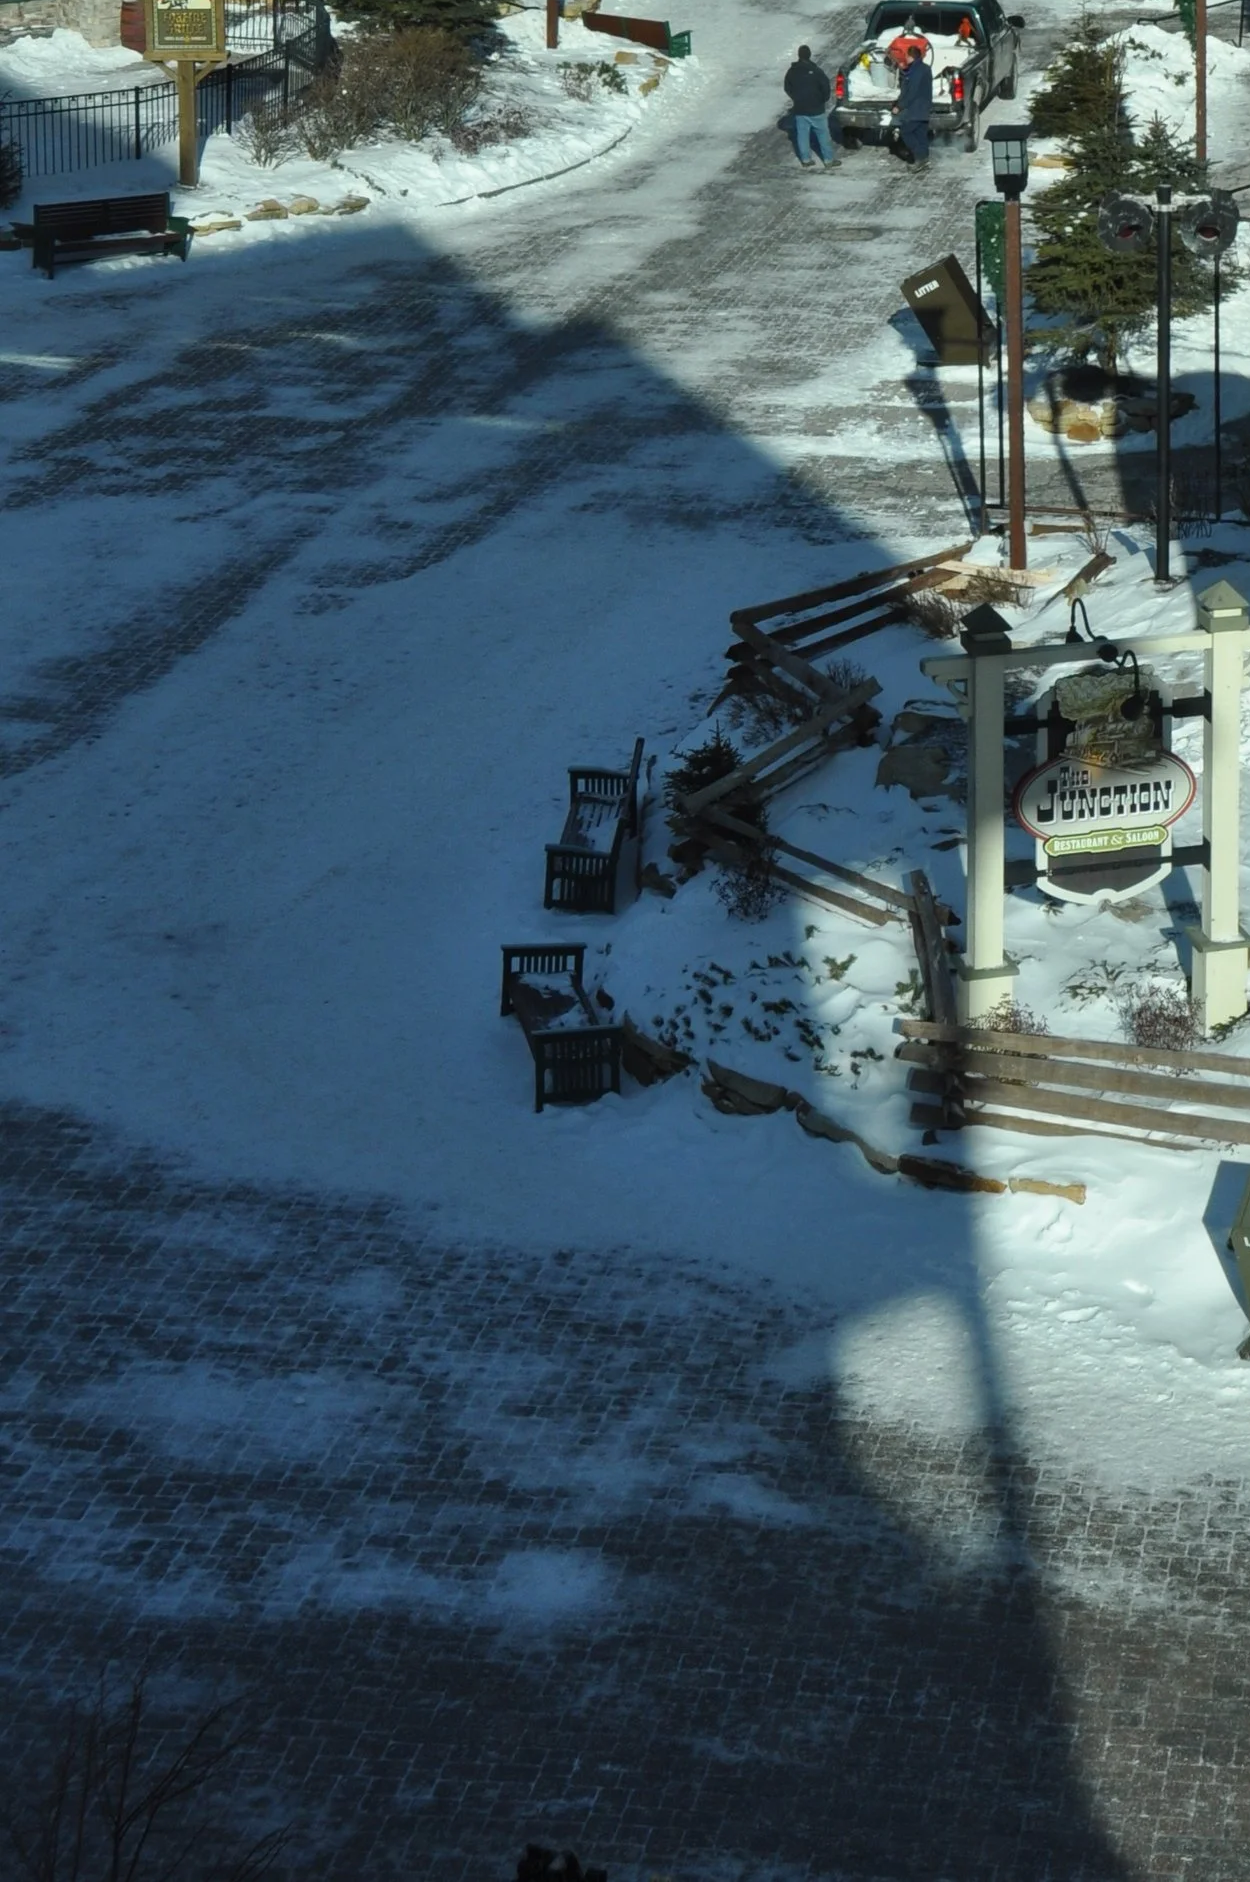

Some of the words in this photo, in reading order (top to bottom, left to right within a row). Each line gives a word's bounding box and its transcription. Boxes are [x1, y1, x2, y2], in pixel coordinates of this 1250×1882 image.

[1037, 780, 1173, 823] JUNCTION
[1053, 835, 1108, 851] RESTAURANT
[1110, 834, 1123, 845] &
[1125, 830, 1160, 843] SALOON
